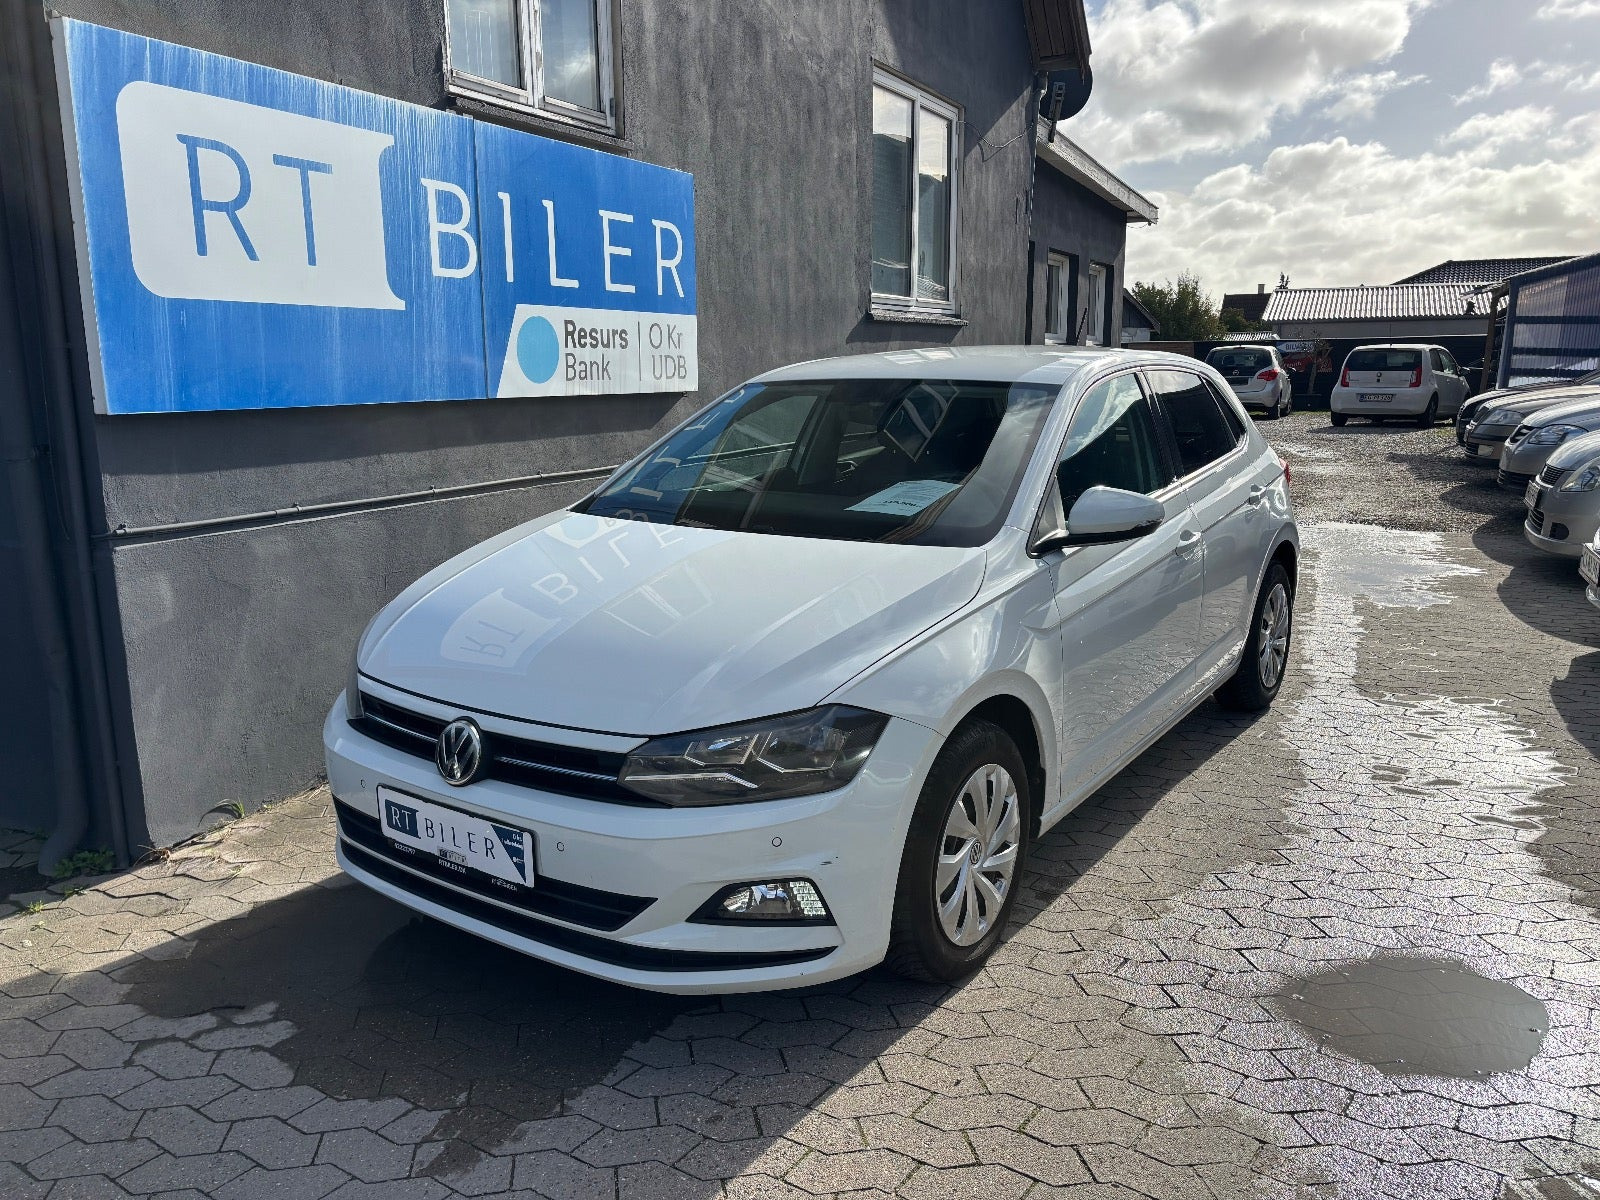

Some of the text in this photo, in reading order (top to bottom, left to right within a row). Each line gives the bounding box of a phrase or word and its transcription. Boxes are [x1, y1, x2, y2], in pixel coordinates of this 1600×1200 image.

[176, 133, 685, 298] RT BILER
[563, 319, 629, 349] Resurs
[667, 323, 683, 350] Kr
[565, 352, 612, 382] Bank
[652, 354, 687, 381] UDB
[390, 805, 412, 830] RT
[424, 817, 496, 860] BILER
